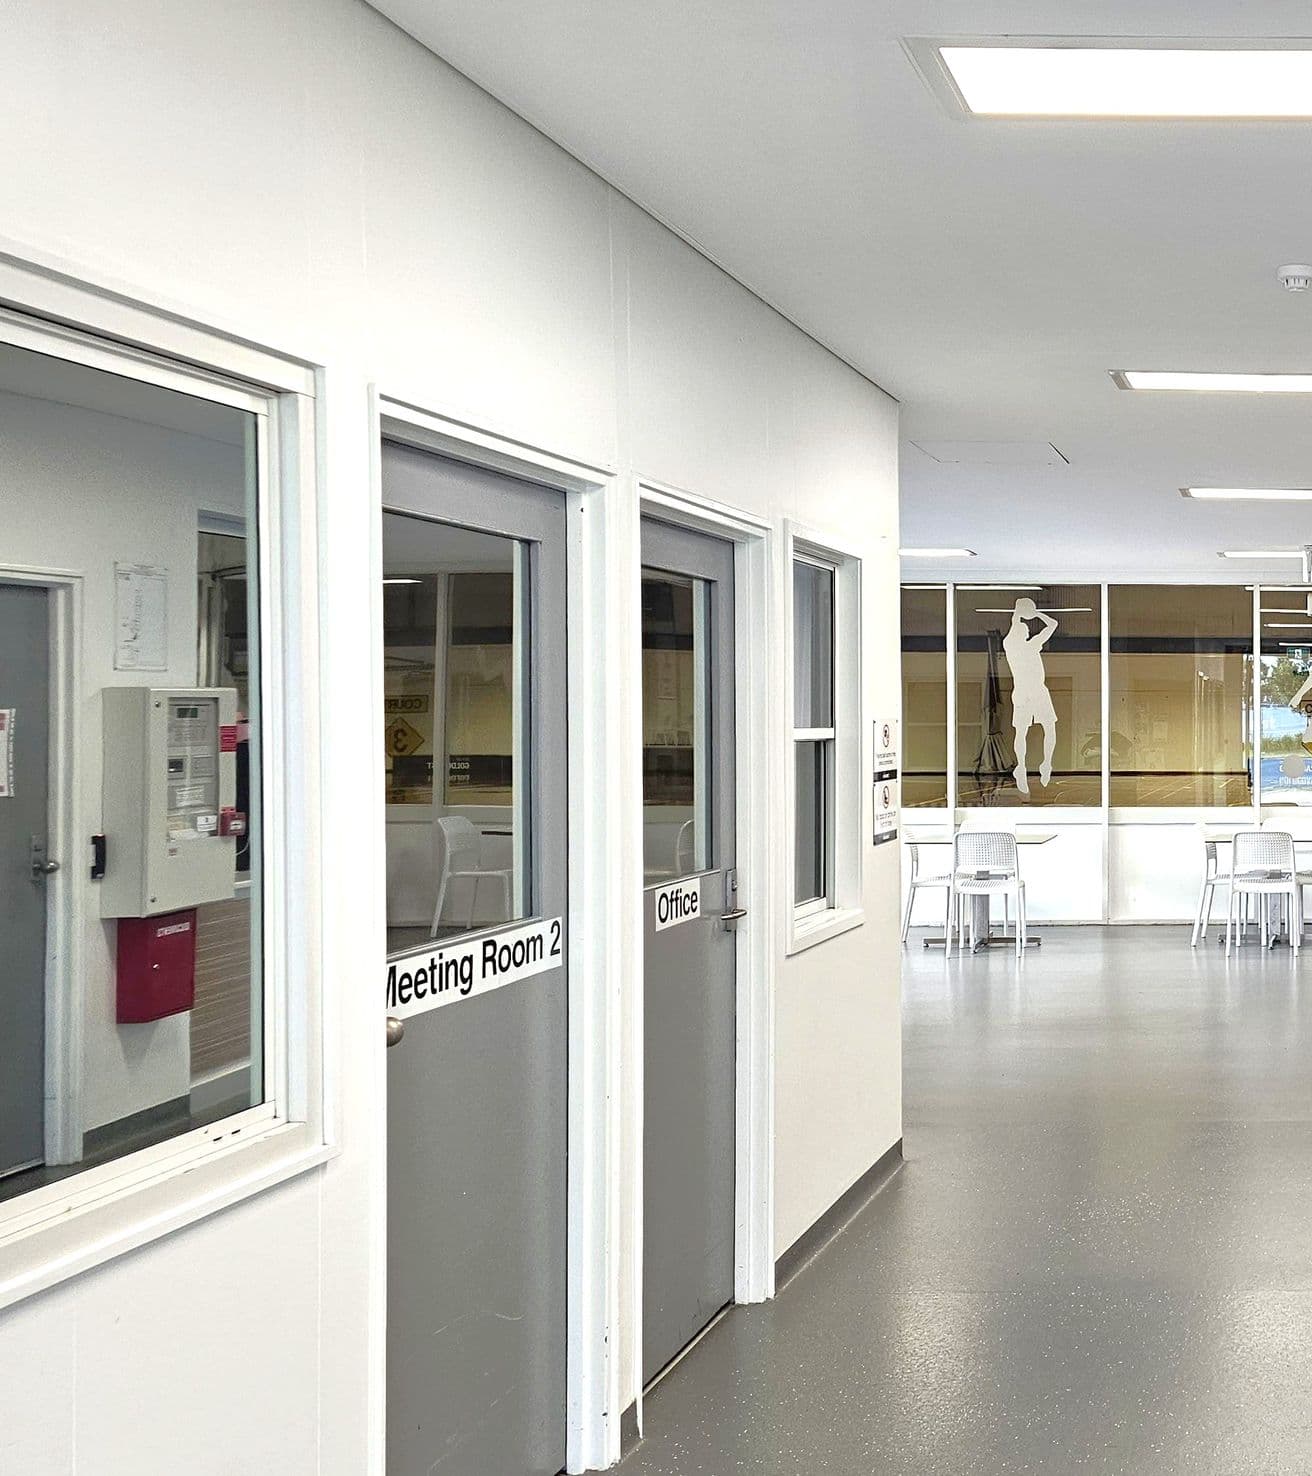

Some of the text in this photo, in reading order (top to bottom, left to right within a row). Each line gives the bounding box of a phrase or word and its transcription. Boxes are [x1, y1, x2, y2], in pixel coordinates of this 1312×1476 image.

[657, 889, 699, 925] Office
[386, 919, 562, 1009] Meeting Room 2
